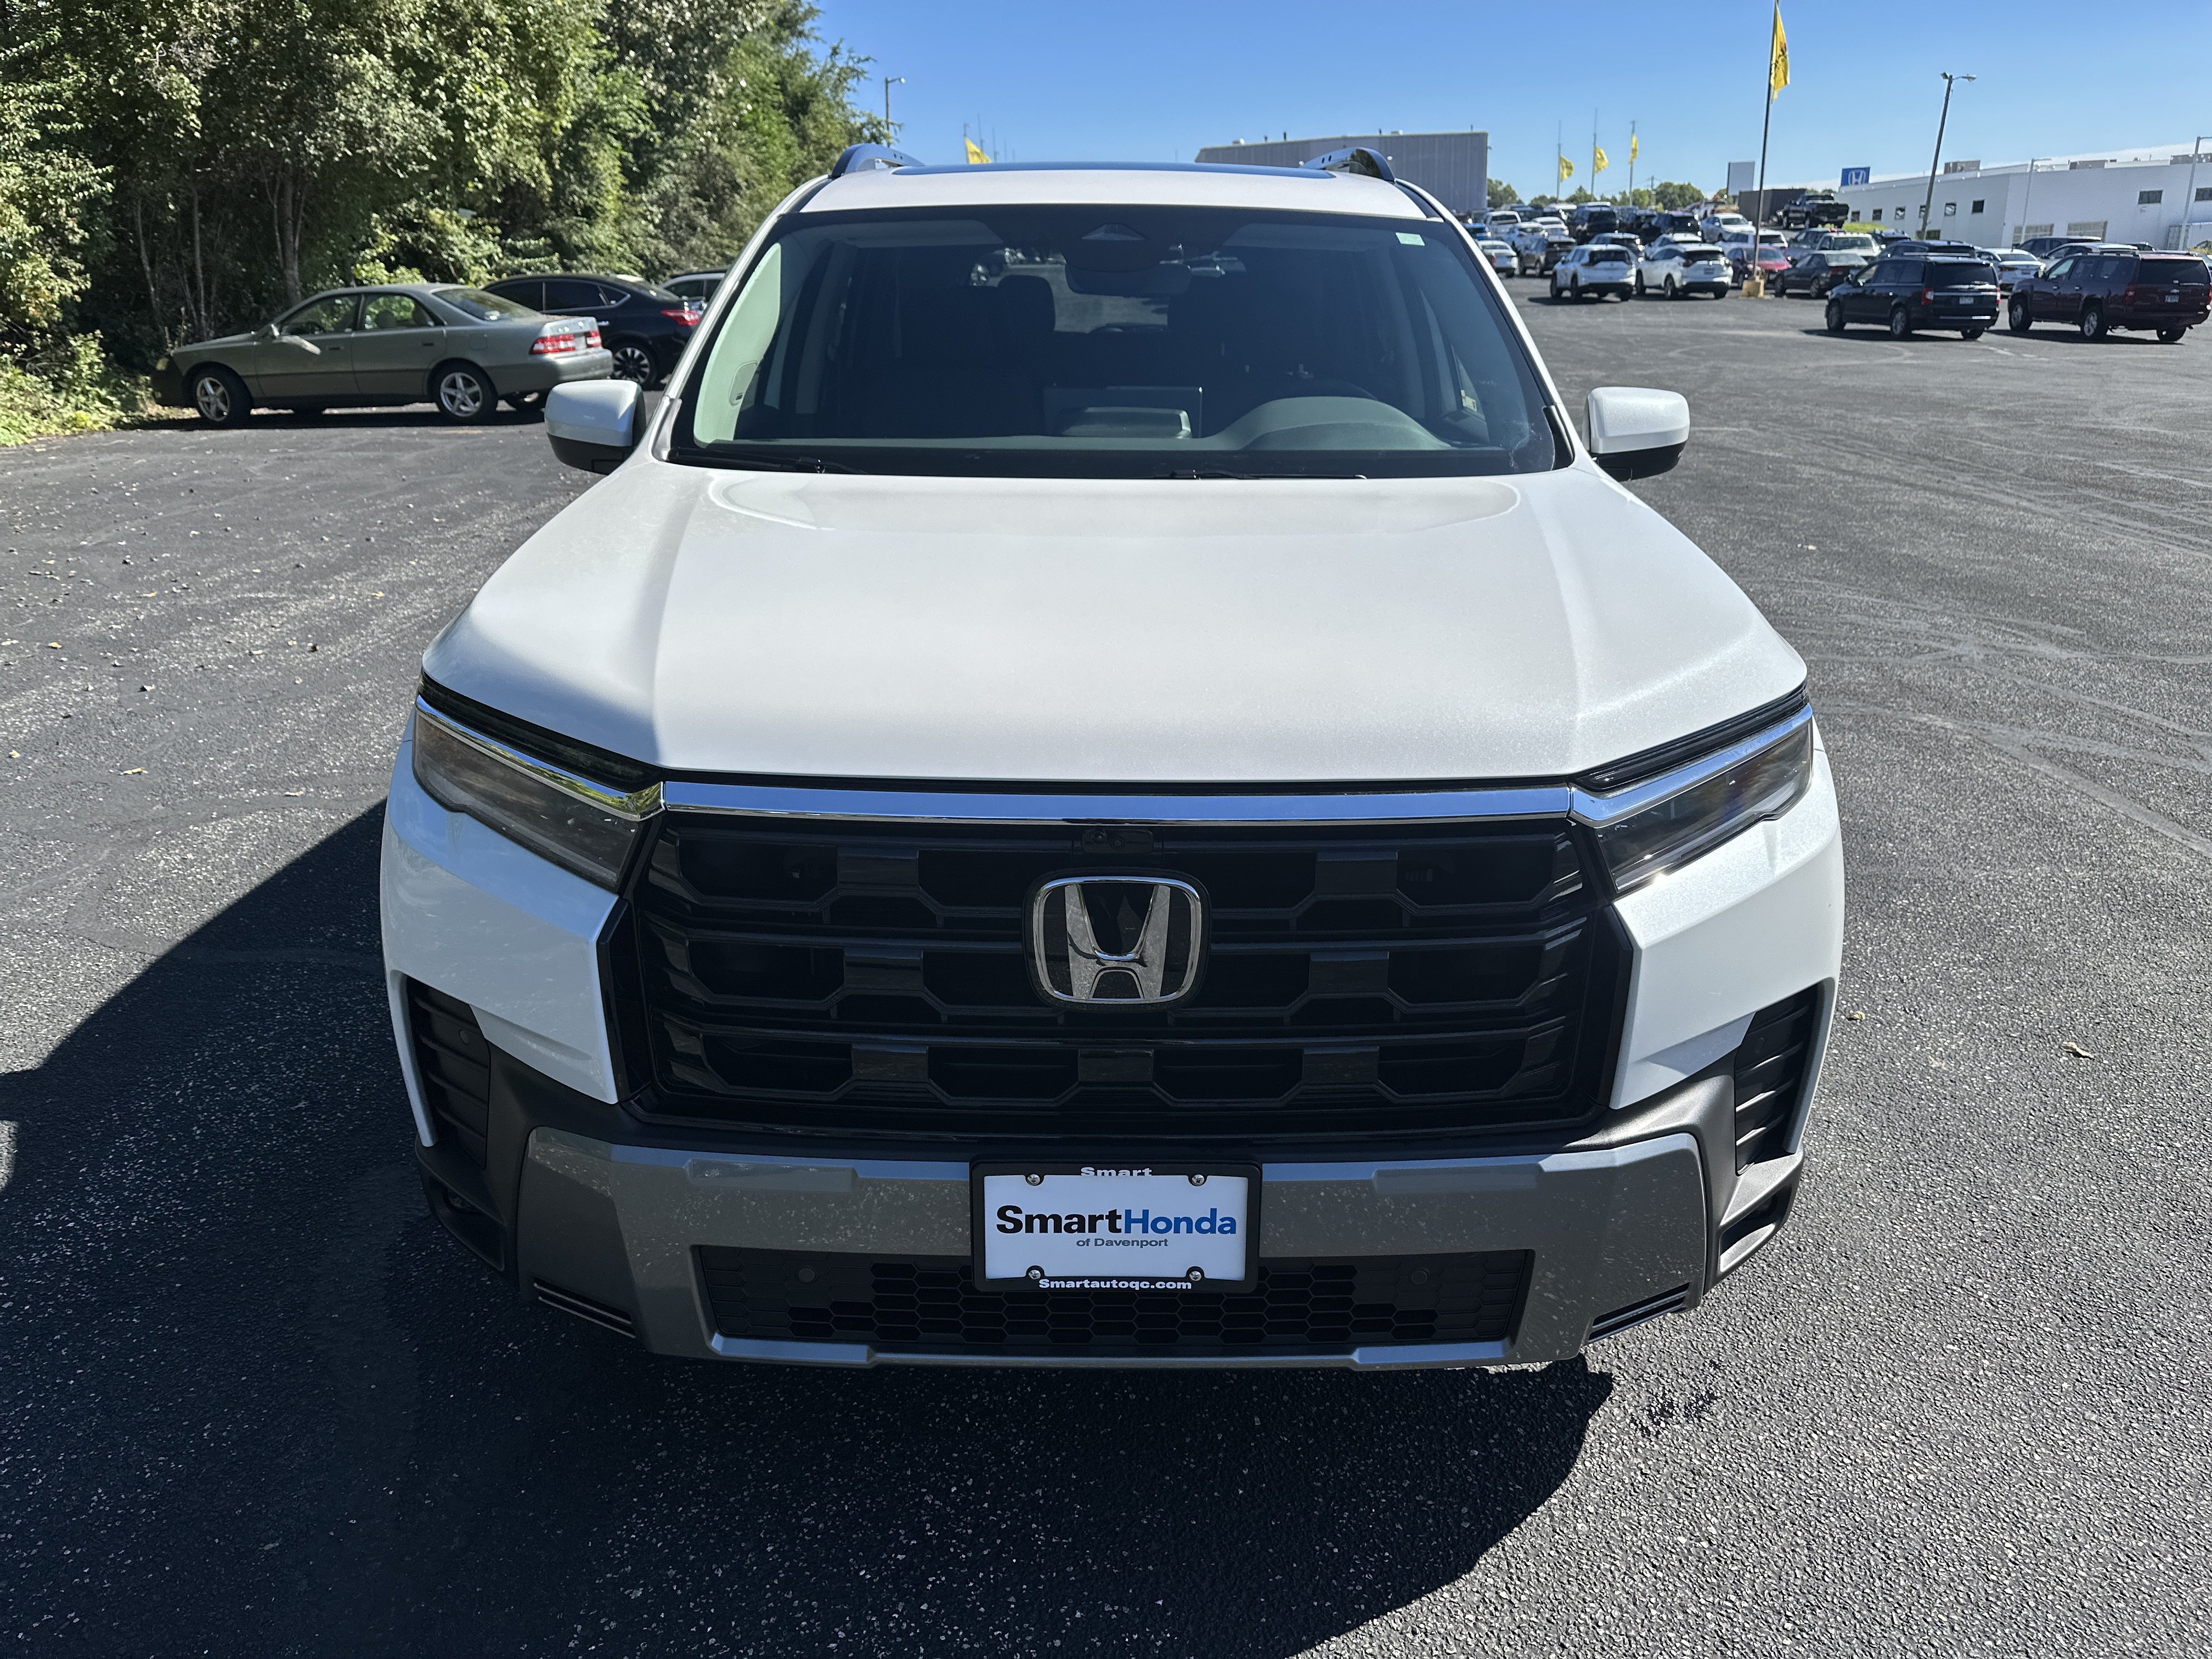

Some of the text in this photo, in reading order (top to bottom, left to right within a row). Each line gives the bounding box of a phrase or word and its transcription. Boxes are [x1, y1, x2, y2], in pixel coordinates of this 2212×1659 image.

[1081, 1166, 1153, 1177] Smart
[1076, 1238, 1169, 1248] of Davenport
[1039, 1279, 1192, 1290] Smartautoqc.com
